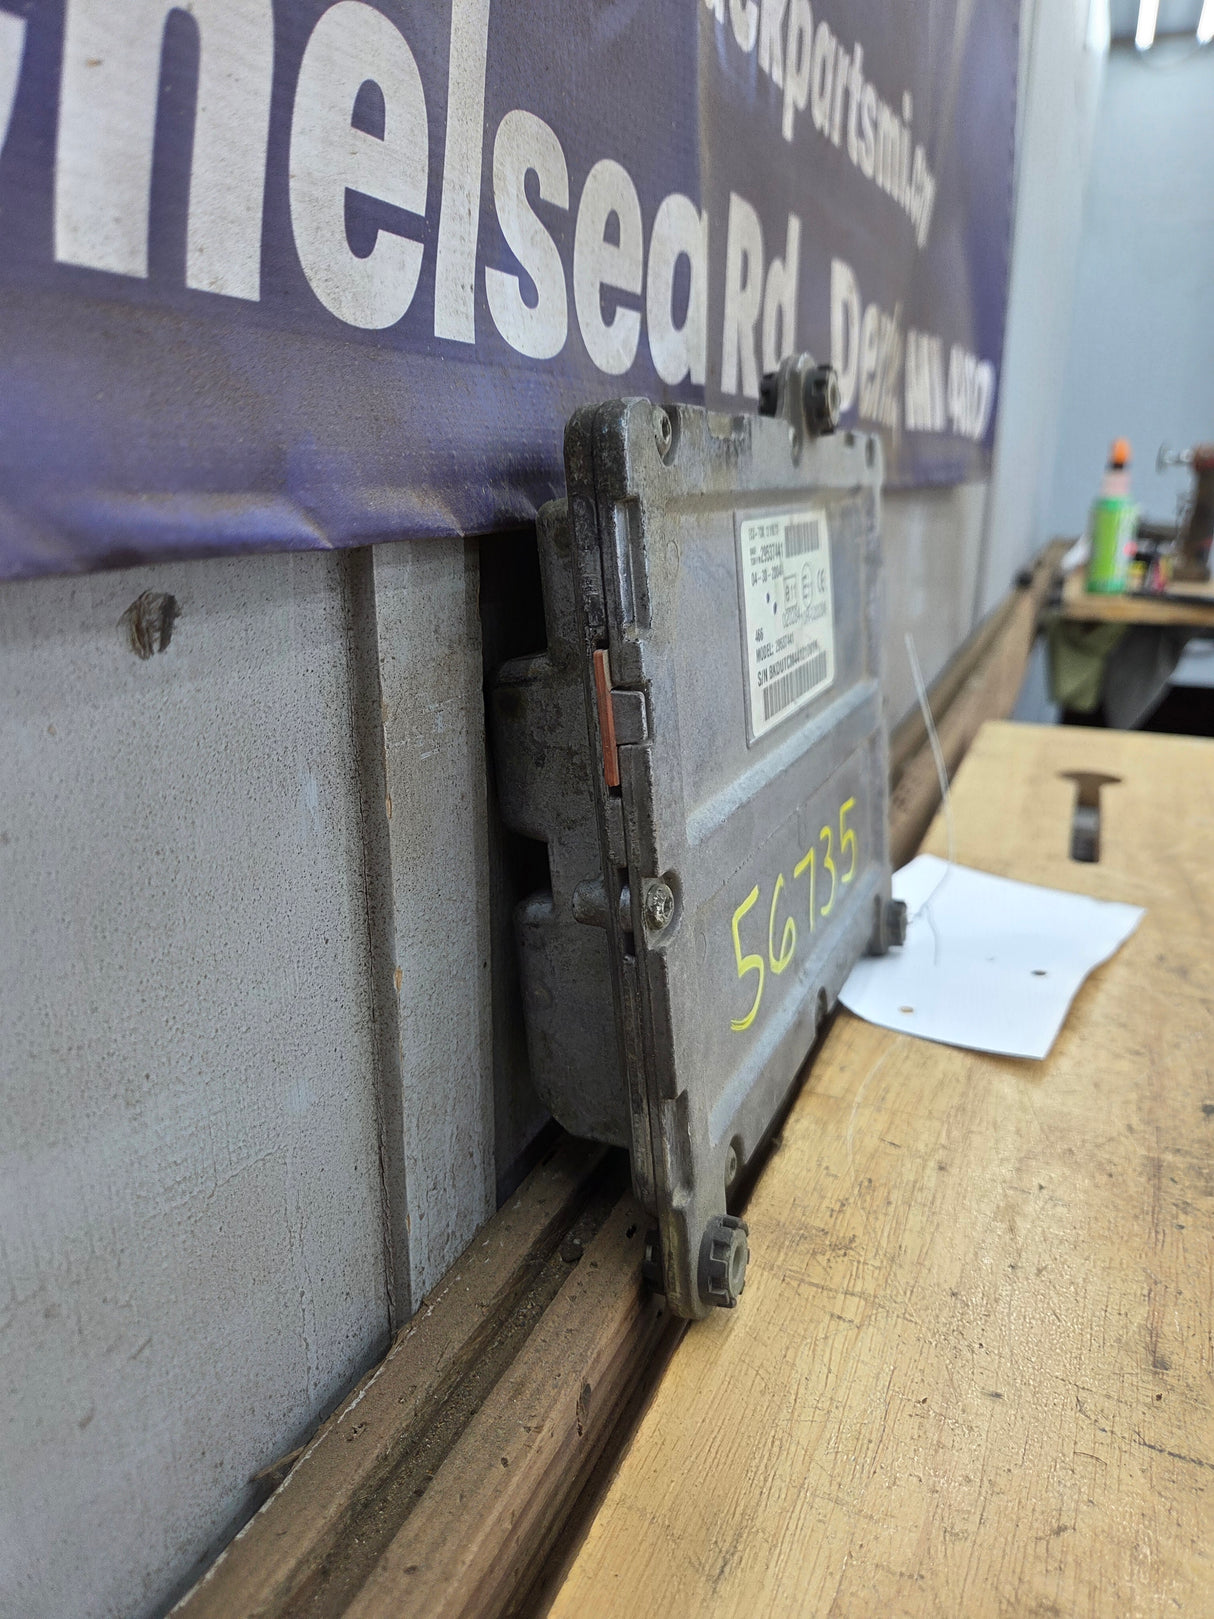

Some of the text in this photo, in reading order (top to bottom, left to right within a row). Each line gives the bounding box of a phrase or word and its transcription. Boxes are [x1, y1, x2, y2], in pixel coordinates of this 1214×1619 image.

[0, 0, 707, 386] helsea
[721, 191, 800, 399] Rd
[756, 643, 774, 664] MODEL:
[757, 668, 768, 687] S/N
[731, 796, 856, 1031] 56735
